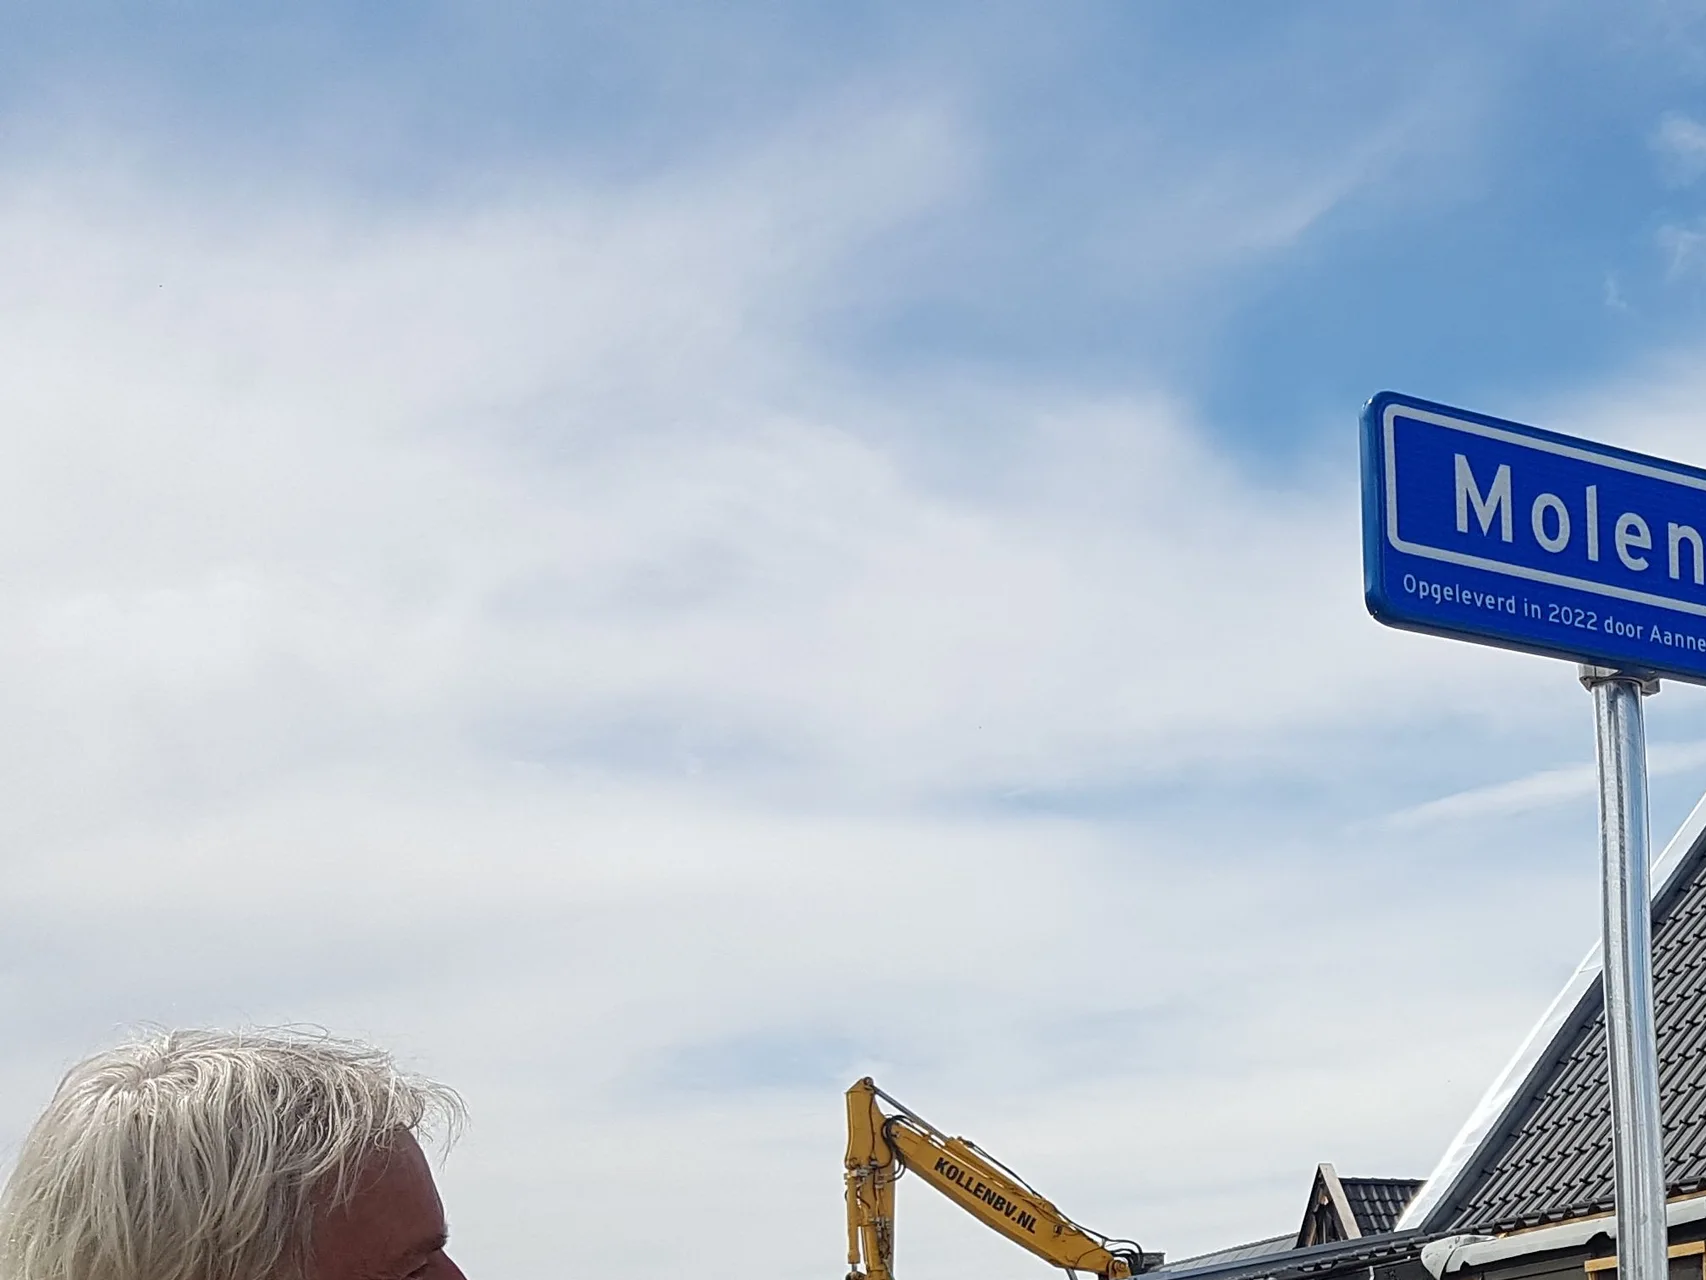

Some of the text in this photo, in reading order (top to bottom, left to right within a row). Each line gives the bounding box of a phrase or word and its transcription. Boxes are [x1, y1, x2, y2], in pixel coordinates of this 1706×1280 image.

[1403, 574, 1515, 614] Opgeleverd
[1524, 598, 1541, 619] in
[1549, 604, 1598, 631] 2022
[1604, 616, 1643, 639] door
[934, 1157, 1037, 1234] KOLLENBV.NL
